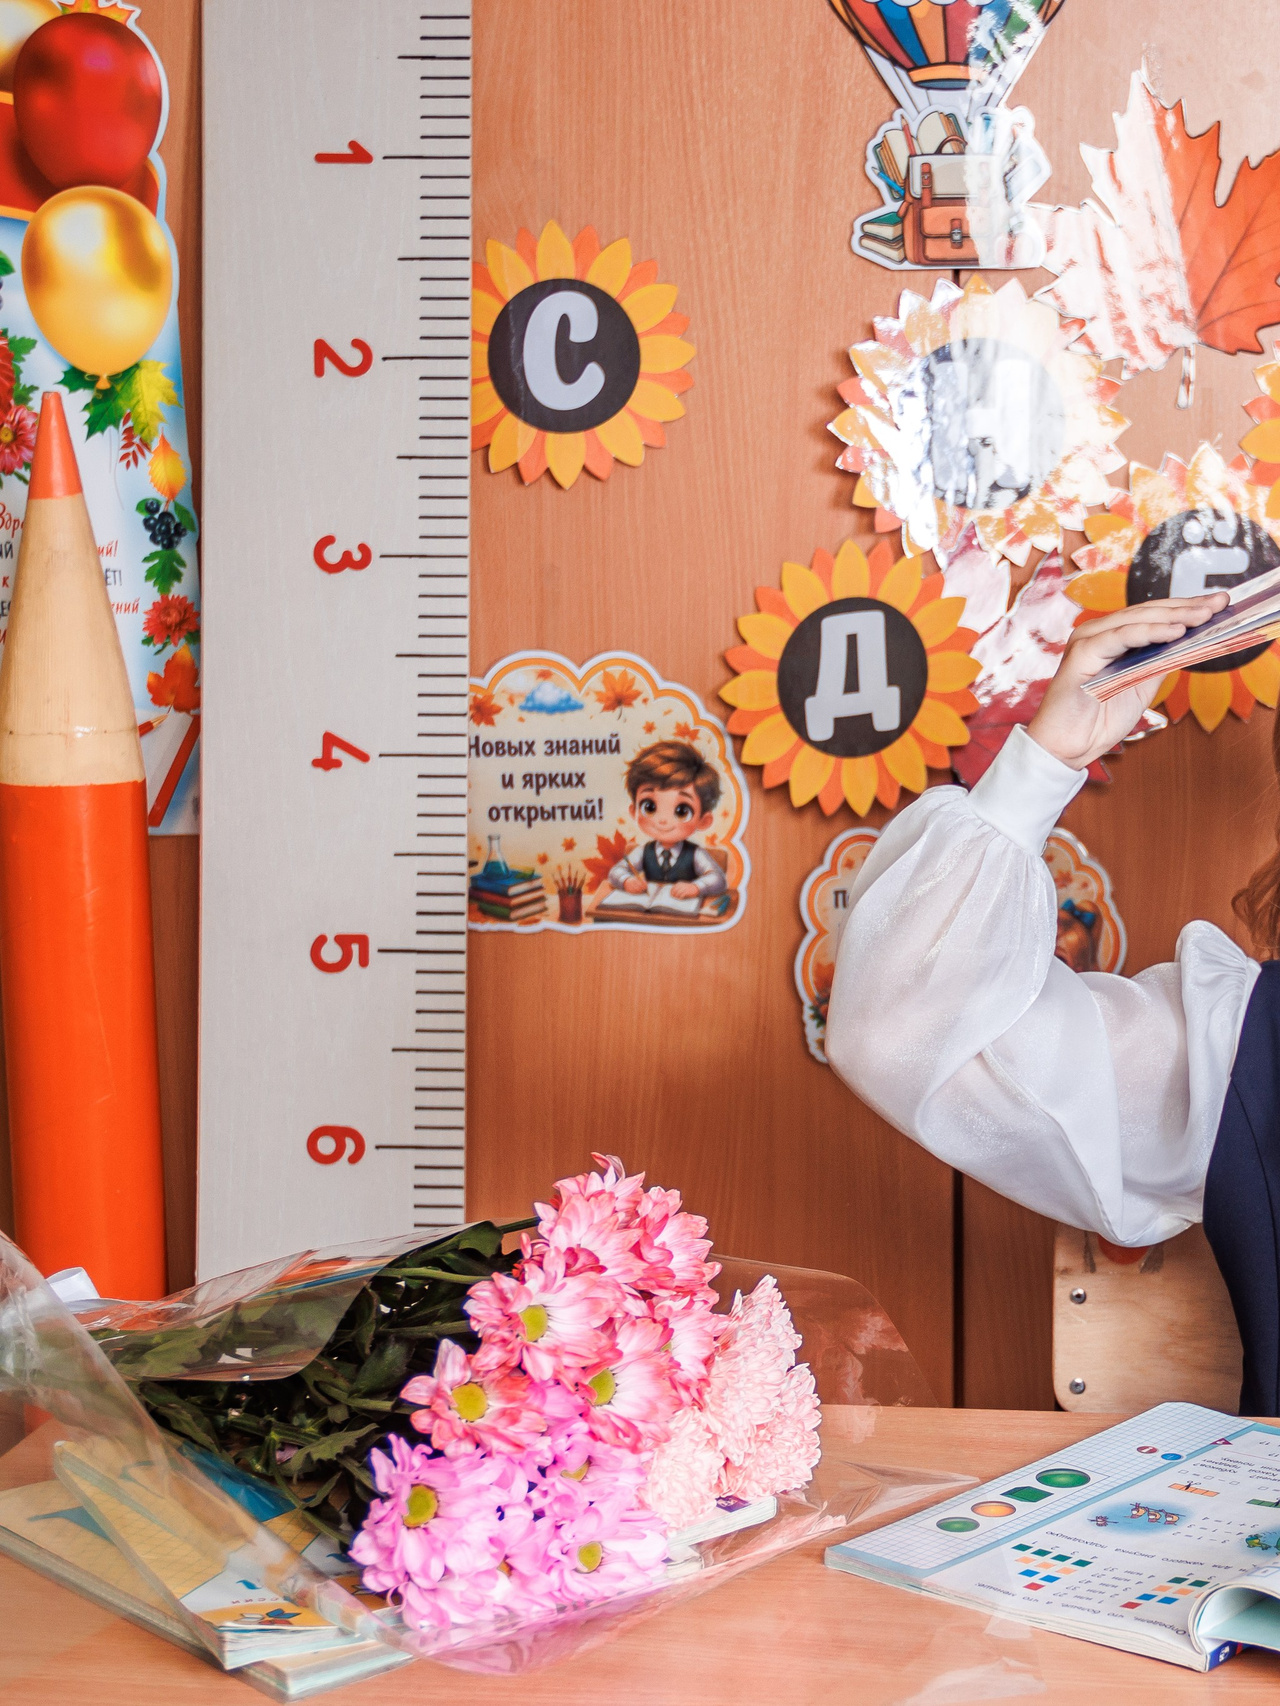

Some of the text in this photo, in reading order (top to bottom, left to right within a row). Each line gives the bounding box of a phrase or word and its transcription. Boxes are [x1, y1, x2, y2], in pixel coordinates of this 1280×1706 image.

[313, 140, 374, 165] 1
[313, 337, 373, 378] 2
[523, 290, 605, 410] С
[312, 534, 372, 574] 3
[804, 609, 901, 742] Д
[311, 731, 371, 771] 4
[469, 733, 621, 758] Новых знаний
[501, 771, 586, 796] и ярких
[488, 797, 604, 829] открытий!
[310, 934, 370, 973] 5
[306, 1125, 366, 1164] 6
